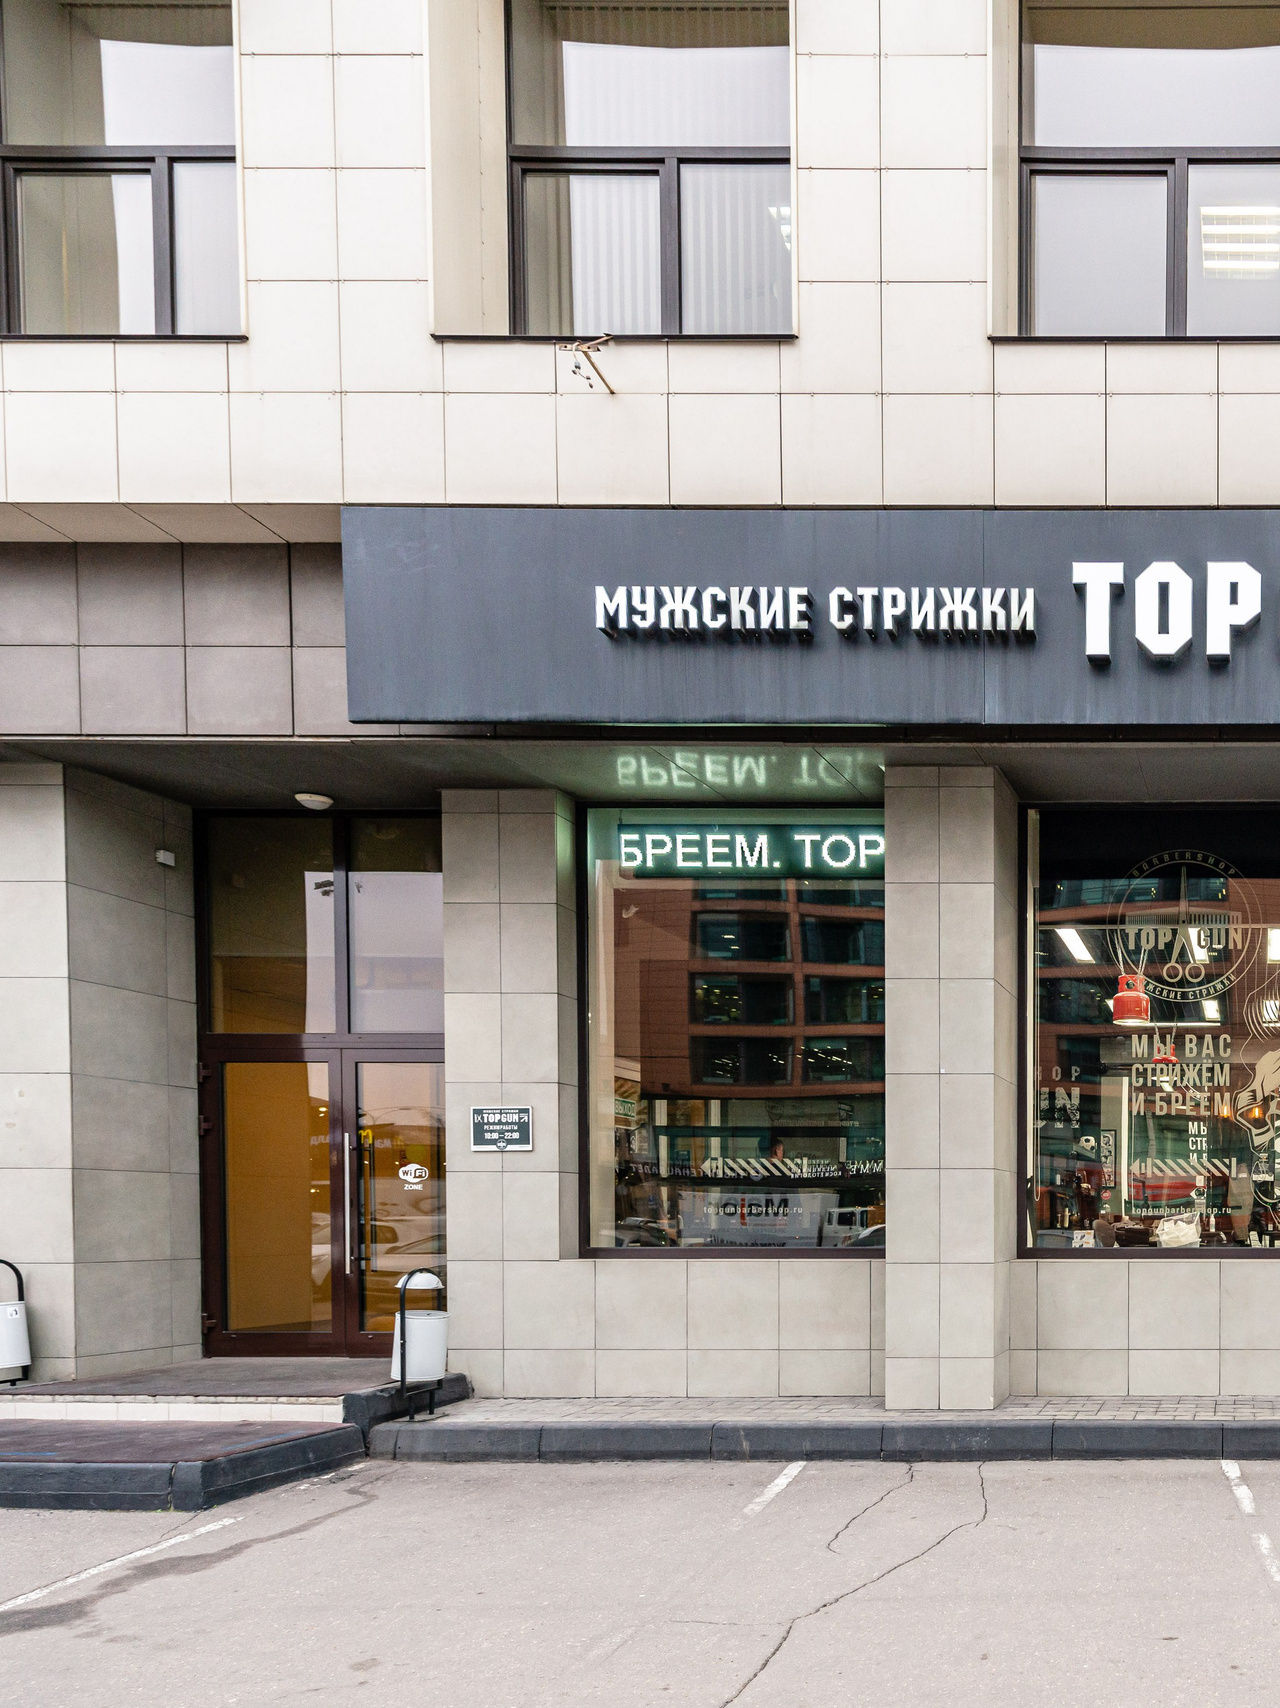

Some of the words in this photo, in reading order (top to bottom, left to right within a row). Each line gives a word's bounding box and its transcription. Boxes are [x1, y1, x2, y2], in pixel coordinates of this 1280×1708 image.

[595, 585, 811, 635] МУЖСКИЕ
[828, 586, 1036, 637] СТРИЖКИ
[620, 833, 781, 868] БРЕЕМ.
[1132, 852, 1236, 878] BARBERSHOP
[1125, 928, 1172, 950] TOP
[1197, 927, 1242, 950] GUN
[1188, 973, 1237, 999] СТРИЖКИ
[1131, 1034, 1171, 1058] МЫ
[1185, 1034, 1231, 1058] ВАС
[1131, 1060, 1231, 1087] СТРИЖЁМ
[1133, 1092, 1145, 1116] И
[1155, 1092, 1231, 1116] БРЕЕМ
[703, 1205, 803, 1216] topgunbarbershop.ru
[1132, 1206, 1232, 1216] topgunbarberop.ru
